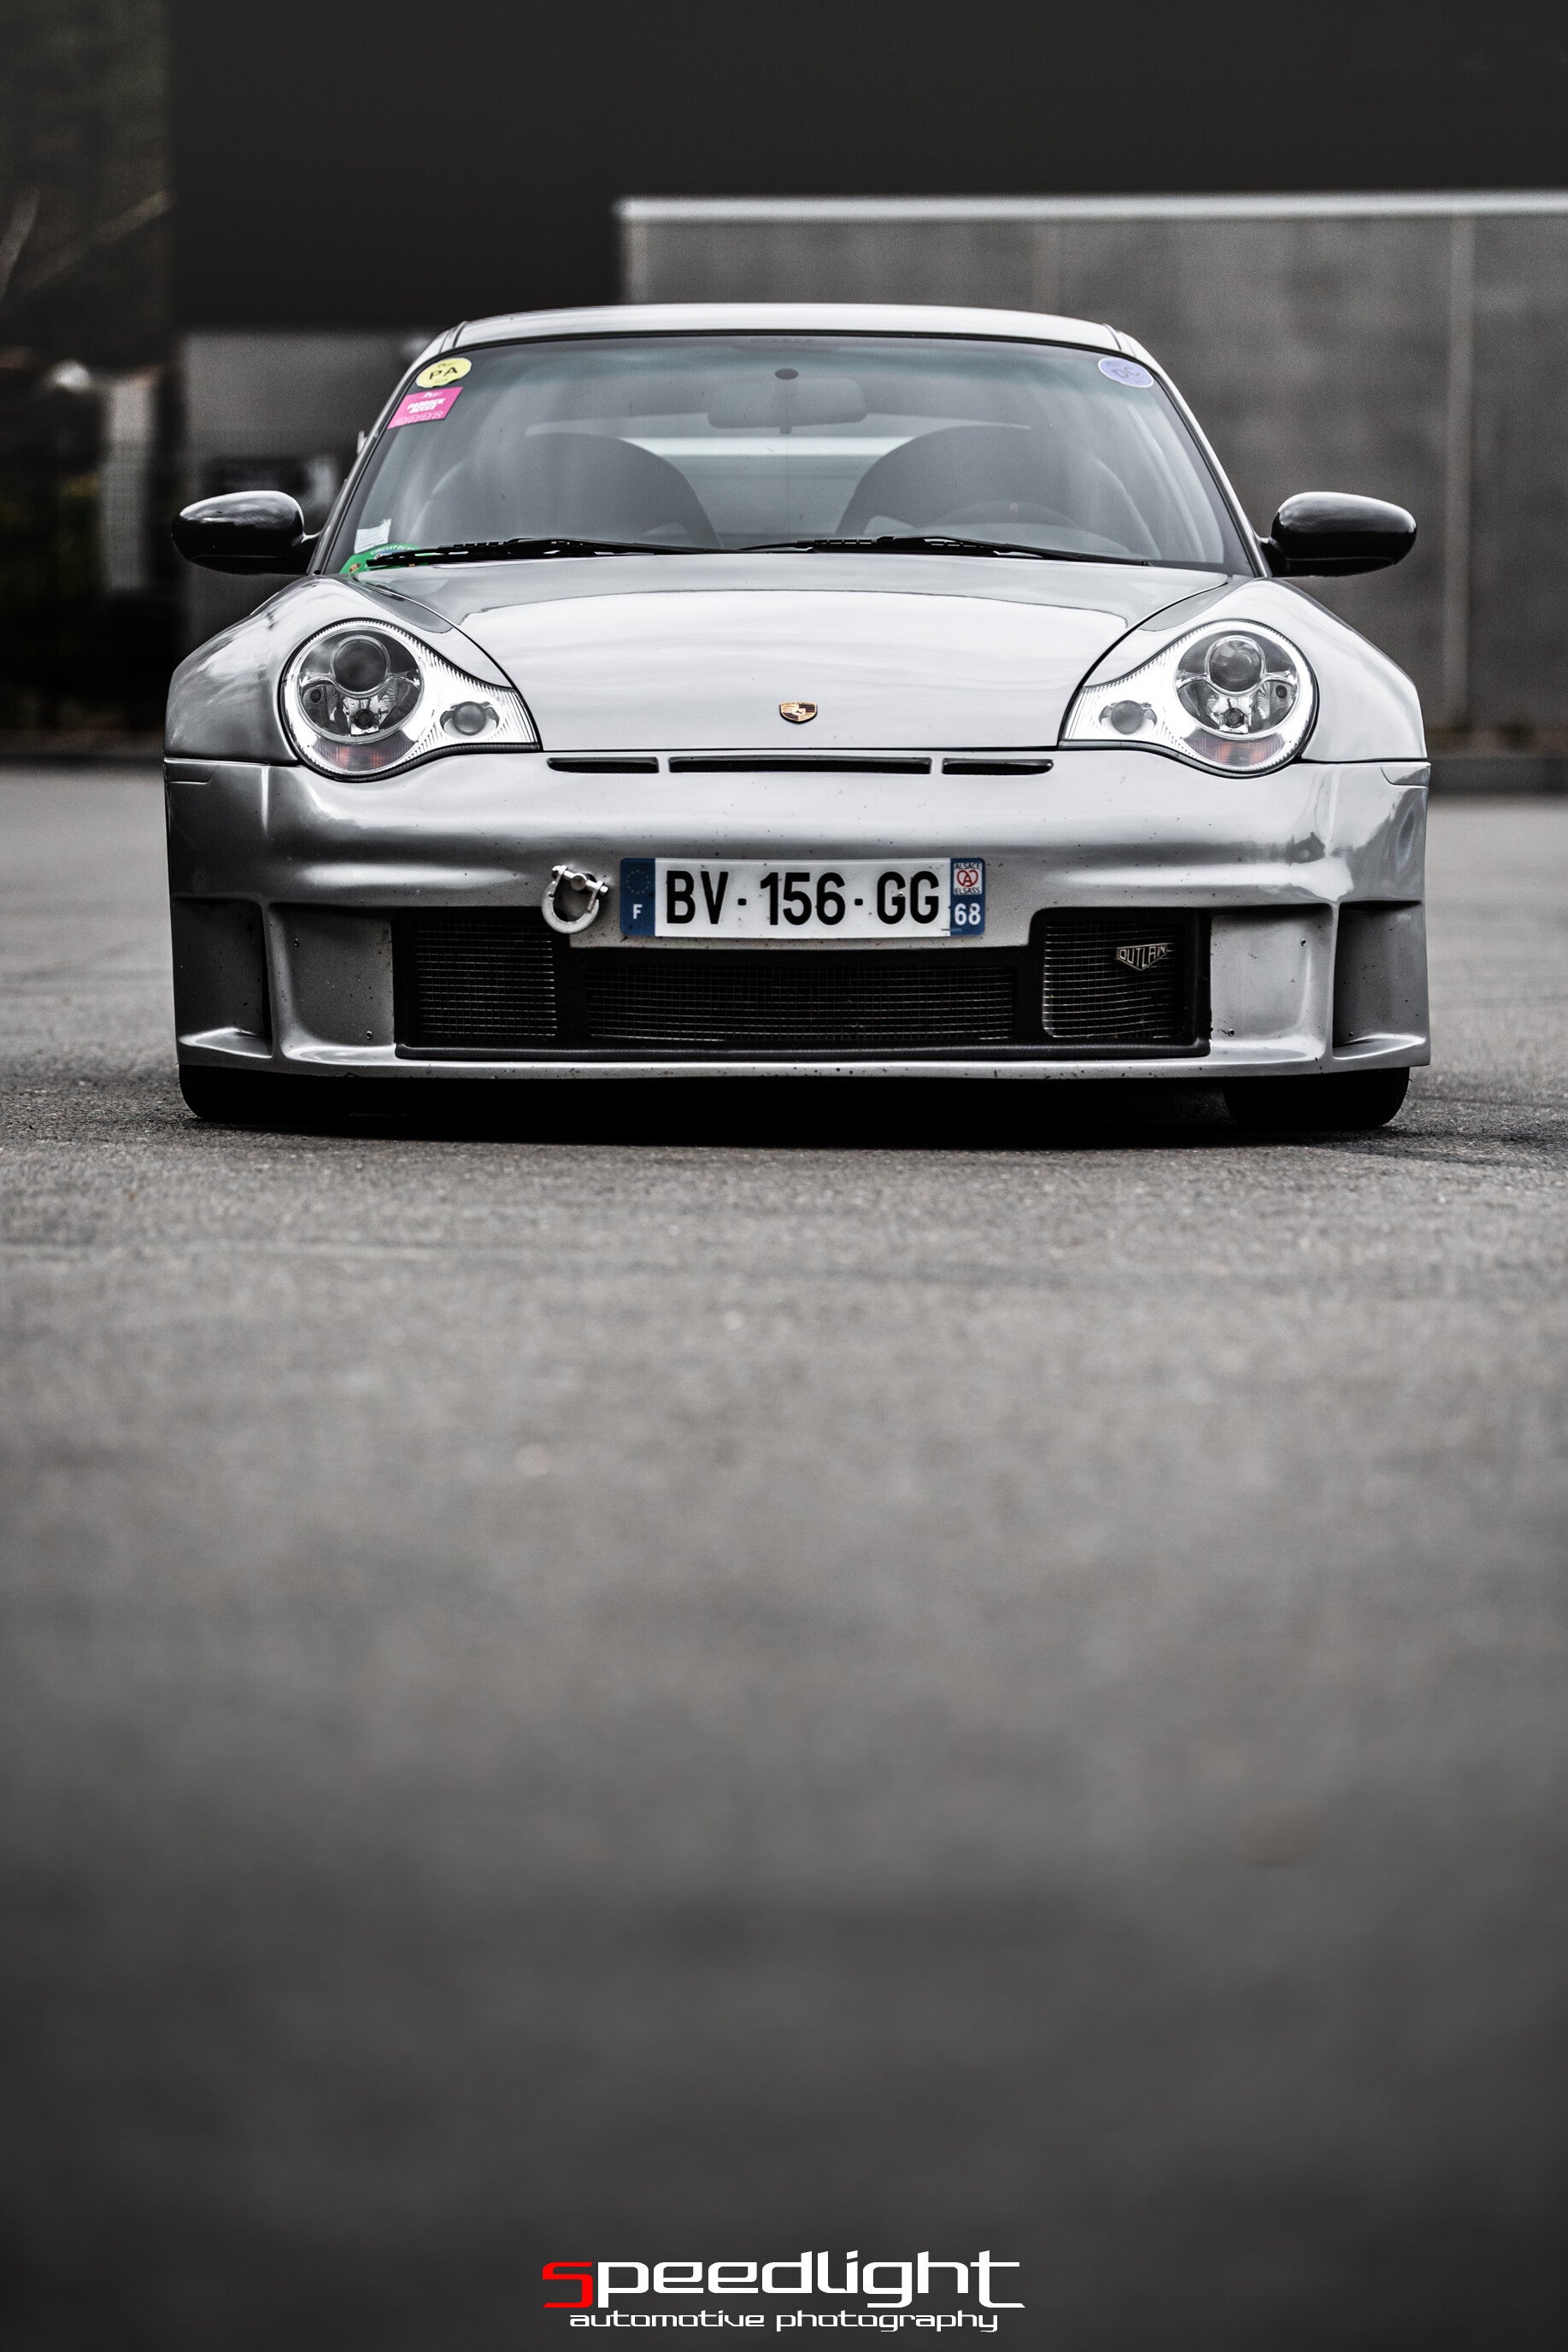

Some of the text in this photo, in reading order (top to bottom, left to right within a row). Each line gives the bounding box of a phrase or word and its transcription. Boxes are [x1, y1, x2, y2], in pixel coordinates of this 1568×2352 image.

[429, 367, 458, 379] PA
[1112, 367, 1140, 379] DC
[632, 903, 643, 920] F
[954, 903, 982, 926] 68
[1119, 945, 1167, 968] OUTLAW
